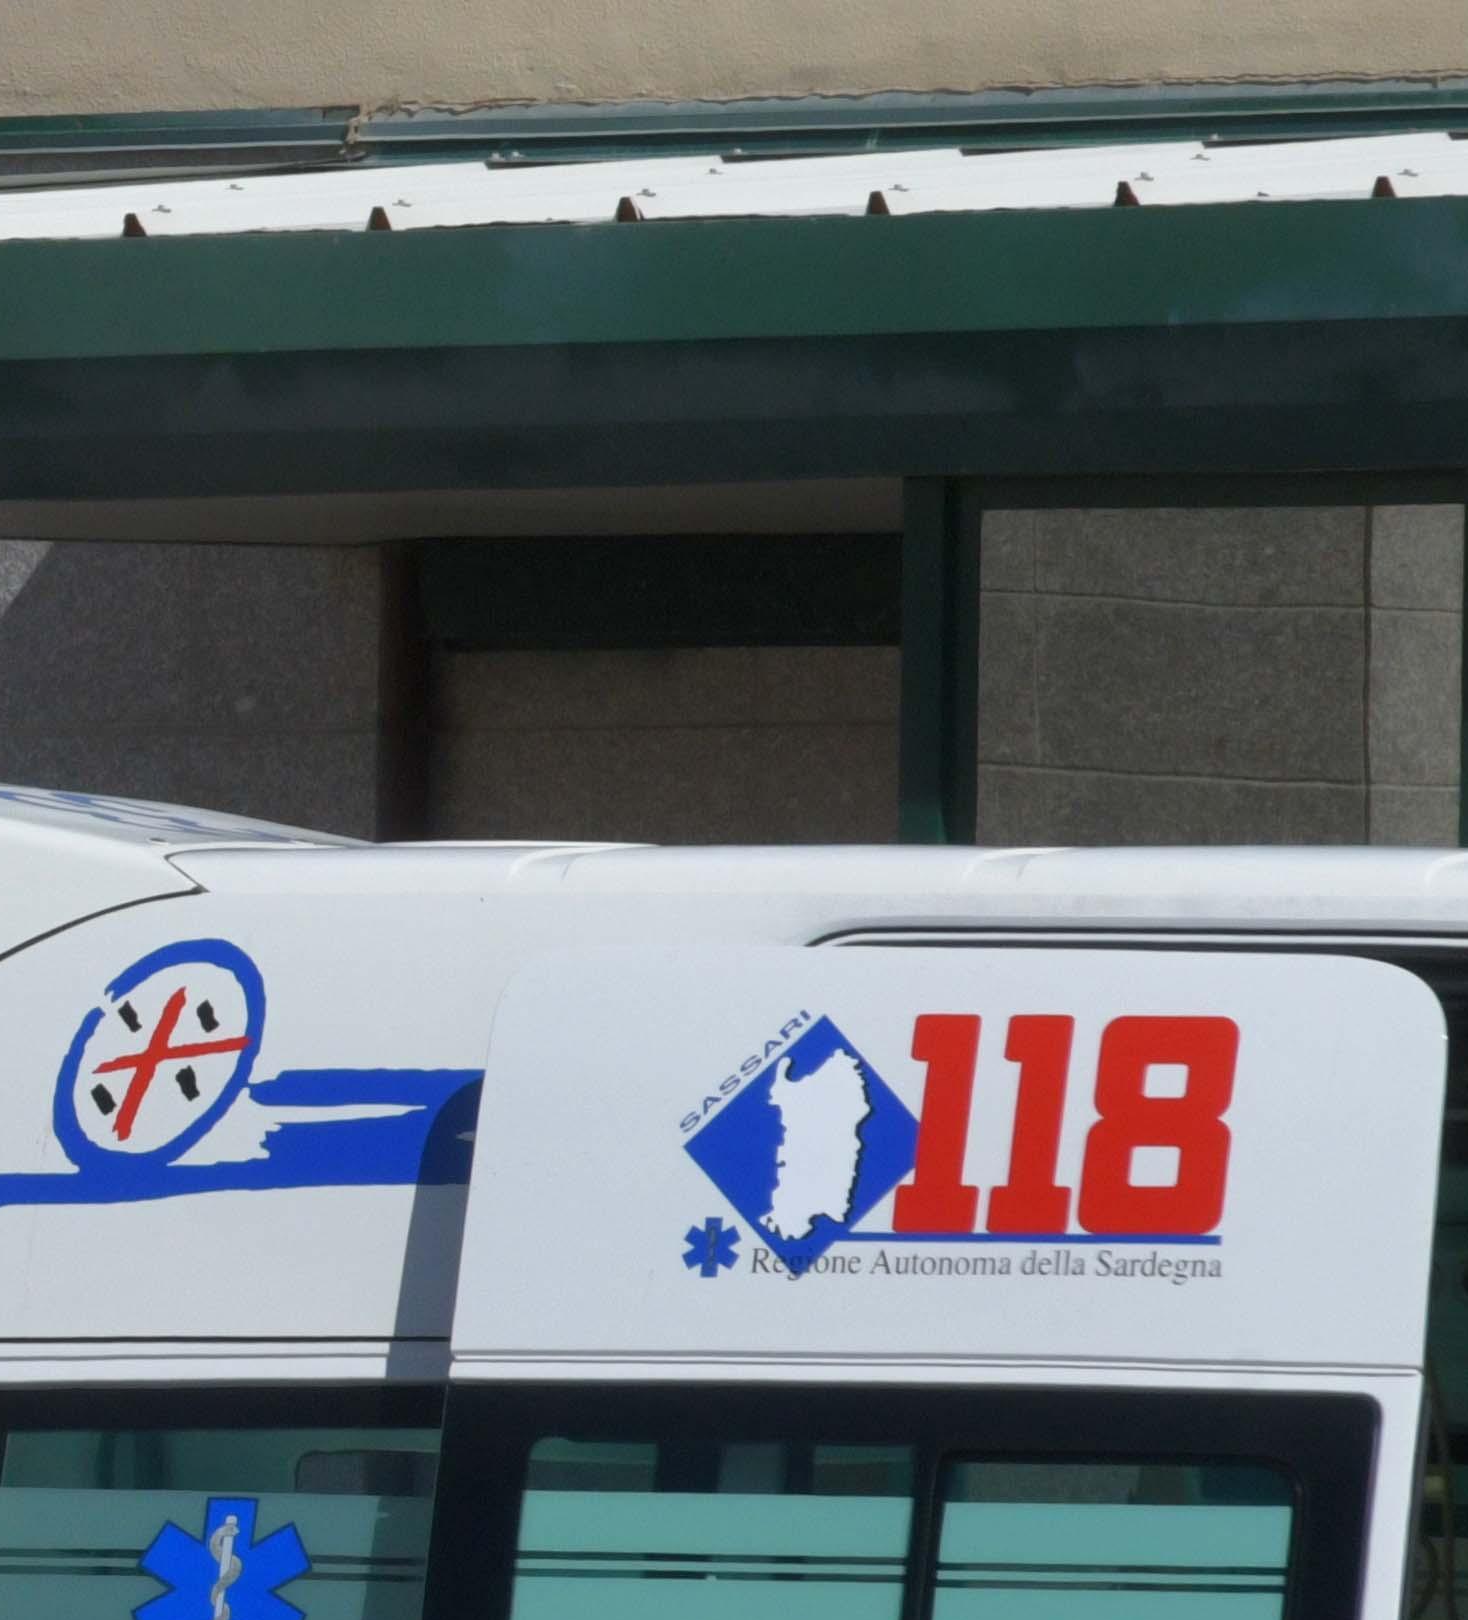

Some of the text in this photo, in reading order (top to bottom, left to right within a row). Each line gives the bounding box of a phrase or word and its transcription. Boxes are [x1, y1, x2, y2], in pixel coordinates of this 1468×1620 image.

[677, 1008, 812, 1134] SASSARI
[891, 1013, 1241, 1236] 118
[750, 1246, 1223, 1286] Regione Autonoma della Sardegna
